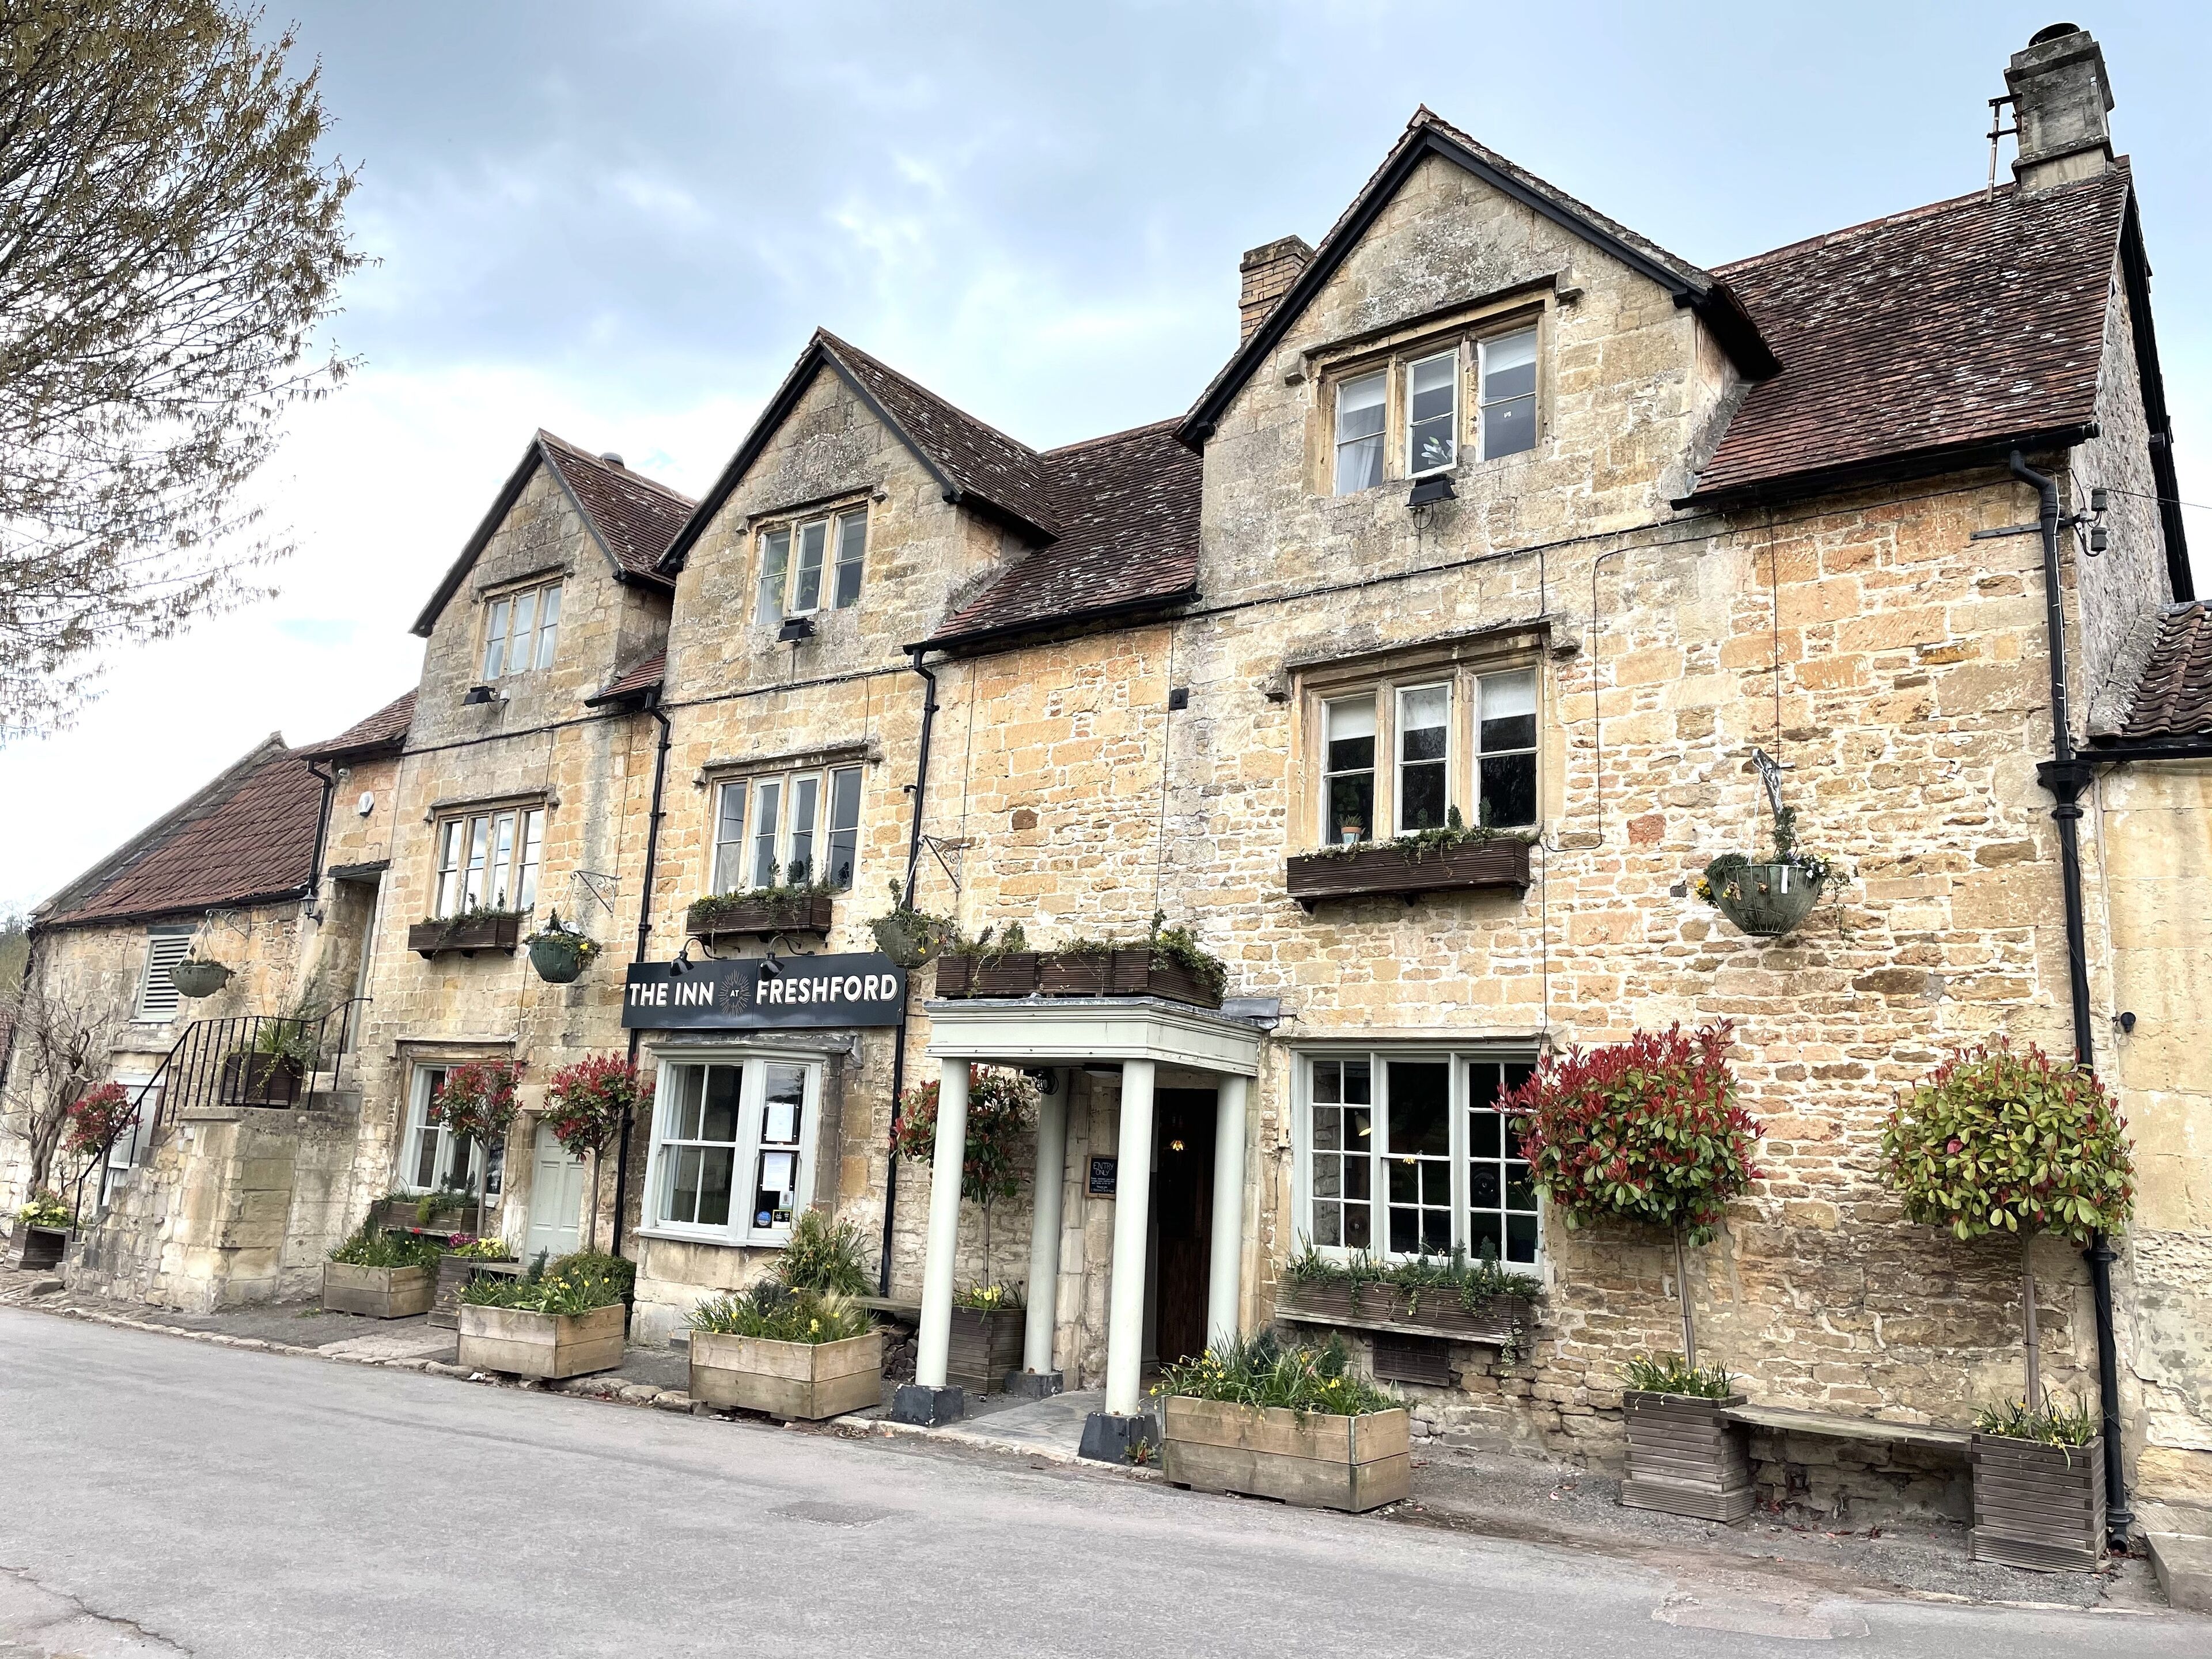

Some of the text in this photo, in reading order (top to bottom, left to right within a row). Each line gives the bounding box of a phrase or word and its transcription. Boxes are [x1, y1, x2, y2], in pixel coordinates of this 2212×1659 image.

[630, 982, 669, 1007] THE
[675, 981, 715, 1007] INN
[756, 974, 898, 1005] FRESHFORD
[1093, 1161, 1114, 1170] ENTRY
